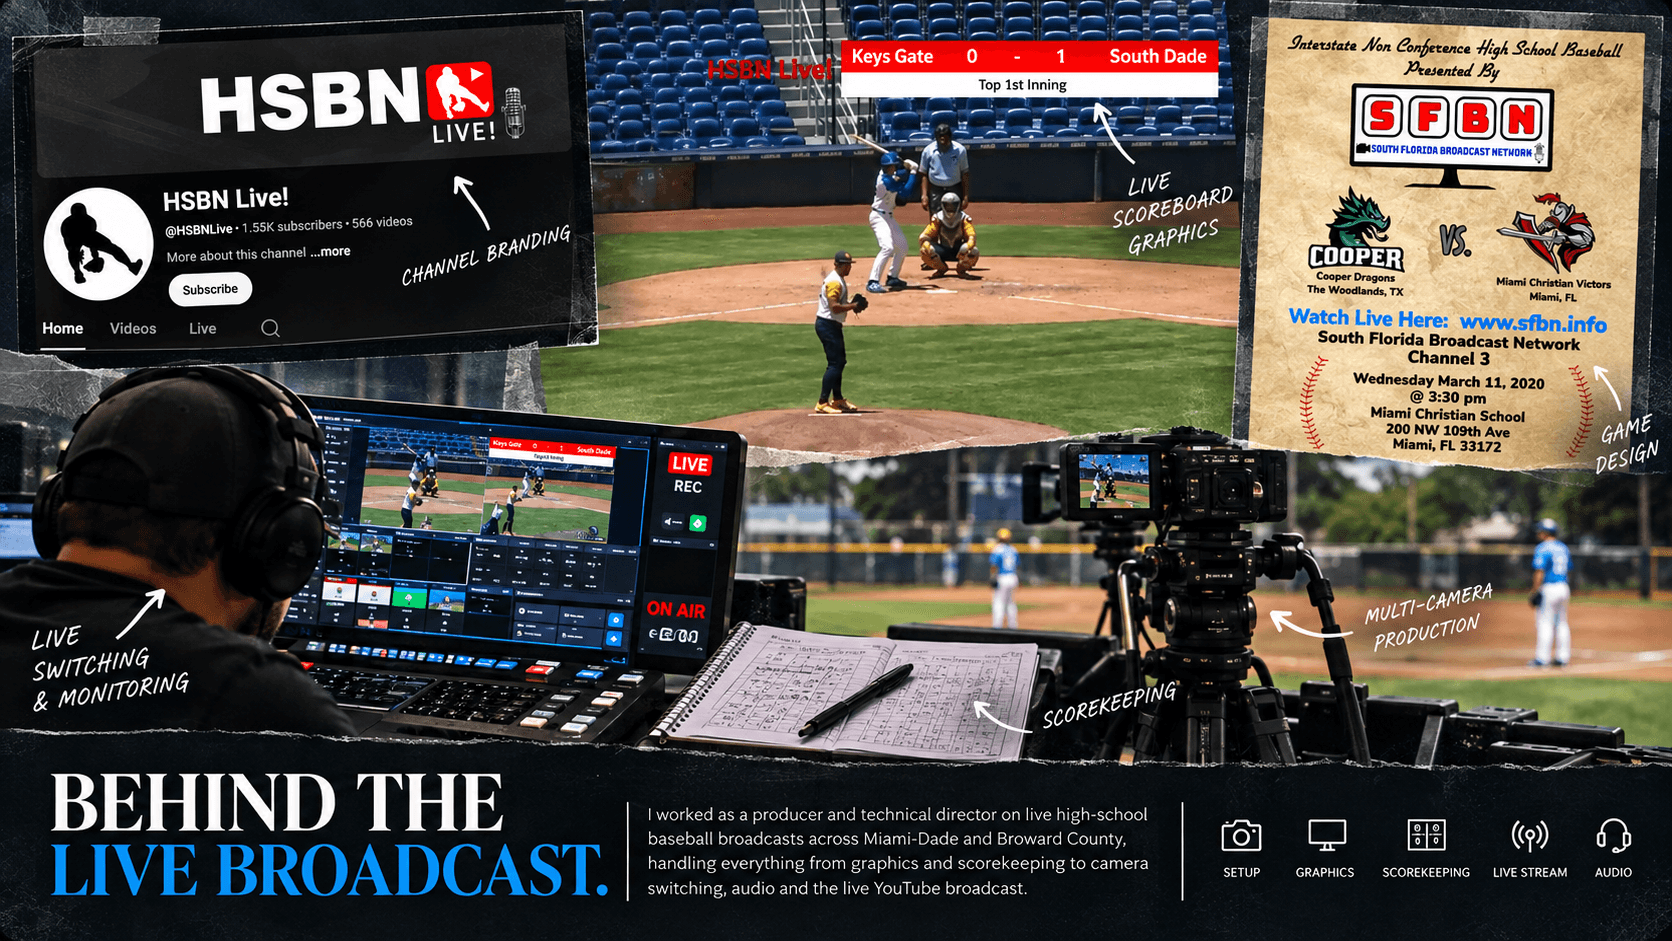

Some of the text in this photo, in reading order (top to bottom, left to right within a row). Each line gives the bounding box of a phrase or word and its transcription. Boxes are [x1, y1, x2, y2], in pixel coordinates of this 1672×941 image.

[1287, 35, 1623, 59] Interstate Non Conference High School Baseball
[1404, 61, 1500, 83] Presented By
[201, 66, 421, 135] HSBN
[1370, 100, 1535, 134] SFBN
[432, 121, 497, 144] LIVE!
[1371, 145, 1532, 157] SOUTH FLORIDA BROADCAST NETWORK
[163, 187, 289, 212] HSBN Live!
[165, 214, 413, 238] @HSBNLive 1.55K subscribers 566 videos
[1440, 224, 1472, 258] VS.
[167, 246, 351, 264] More about this channel ...more
[1308, 244, 1405, 273] COOPER
[1316, 271, 1396, 285] Cooper Dragons
[1496, 278, 1612, 289] Miami Christian Victors
[182, 282, 238, 296] Subscribe
[1307, 284, 1404, 298] The Woodlands, TX
[1529, 292, 1577, 303] Miami, FL
[42, 322, 83, 335] Home
[110, 322, 157, 335] Videos
[189, 322, 217, 335] Live
[1289, 308, 1608, 333] Watch Live Here: www.sfbn.info
[1318, 330, 1581, 351] South Florida Broadcast Network
[1407, 350, 1490, 366] Channel 3
[1353, 373, 1545, 391] Wednesday March 11, 2020
[1410, 391, 1487, 406] @ 3:30 pm
[1370, 406, 1526, 423] Miami Christian School
[1386, 423, 1510, 438] 200 NW 109th Ave
[1392, 439, 1501, 453] Miami, FL 33172
[673, 456, 709, 472] LIVE
[674, 480, 703, 493] REC
[647, 600, 705, 619] ON AIR
